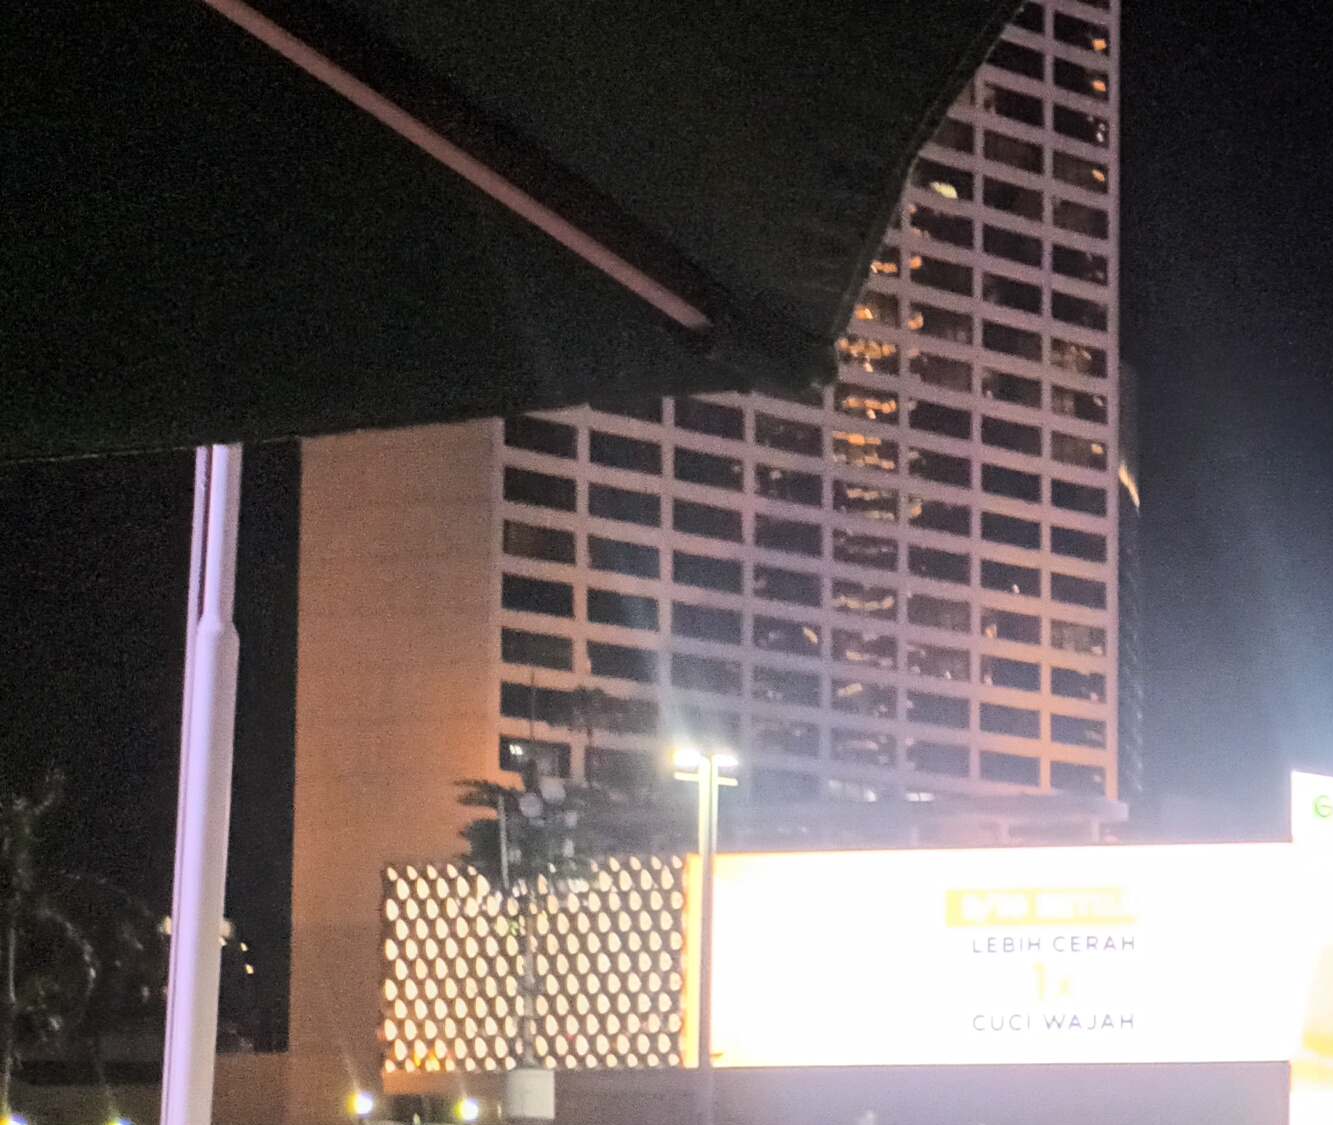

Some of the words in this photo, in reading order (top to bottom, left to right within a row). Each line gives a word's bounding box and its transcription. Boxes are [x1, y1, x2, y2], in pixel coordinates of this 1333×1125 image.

[972, 936, 1041, 953] LEBIH
[1052, 935, 1135, 953] CERAH
[972, 1013, 1031, 1032] CUCI
[1043, 1013, 1134, 1031] WAJAH
